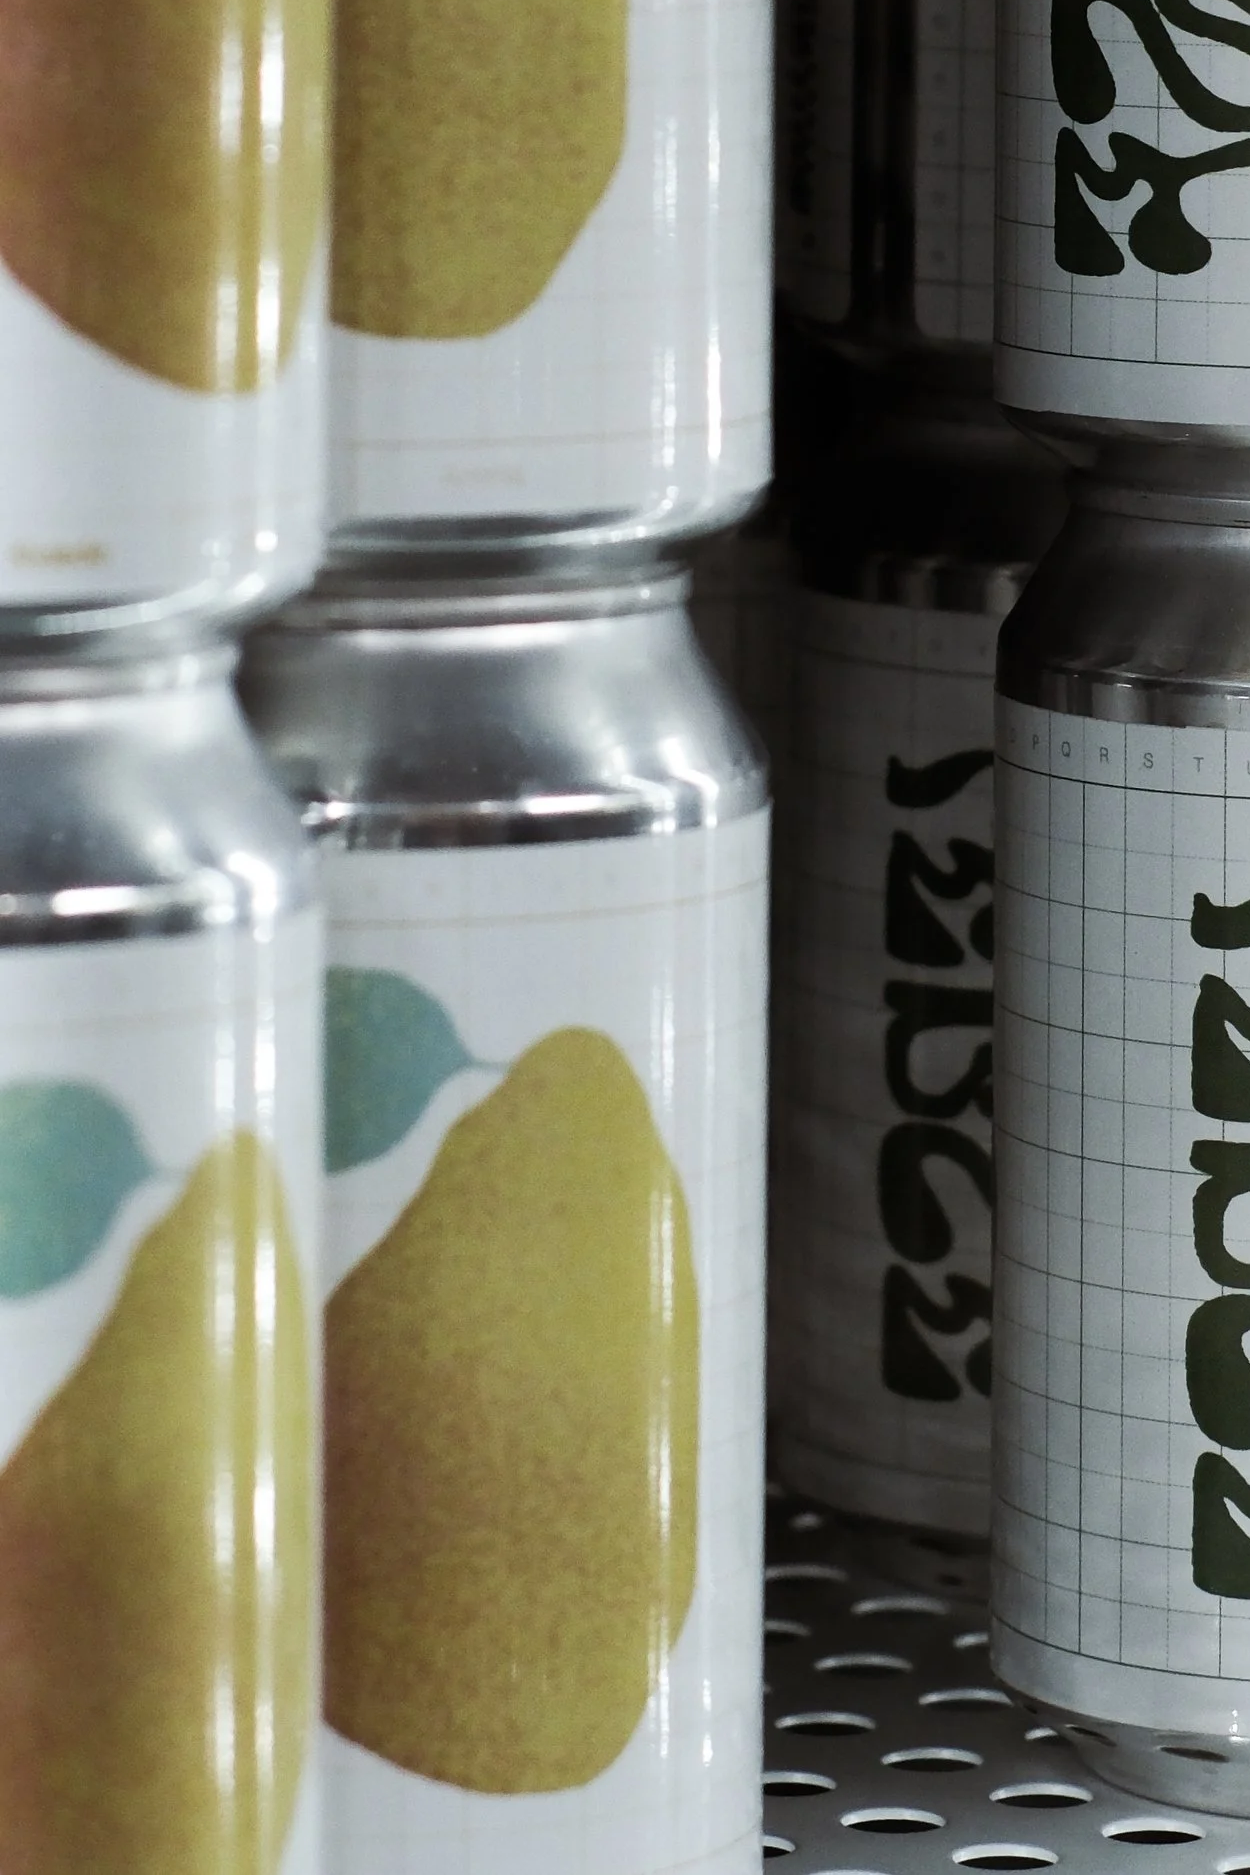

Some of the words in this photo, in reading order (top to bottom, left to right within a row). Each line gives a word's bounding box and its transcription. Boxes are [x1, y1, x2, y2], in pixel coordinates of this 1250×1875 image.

[1032, 734, 1040, 750] P
[1061, 741, 1071, 758] Q
[1099, 747, 1110, 764] R
[1143, 752, 1154, 770] S
[1193, 756, 1204, 773] T
